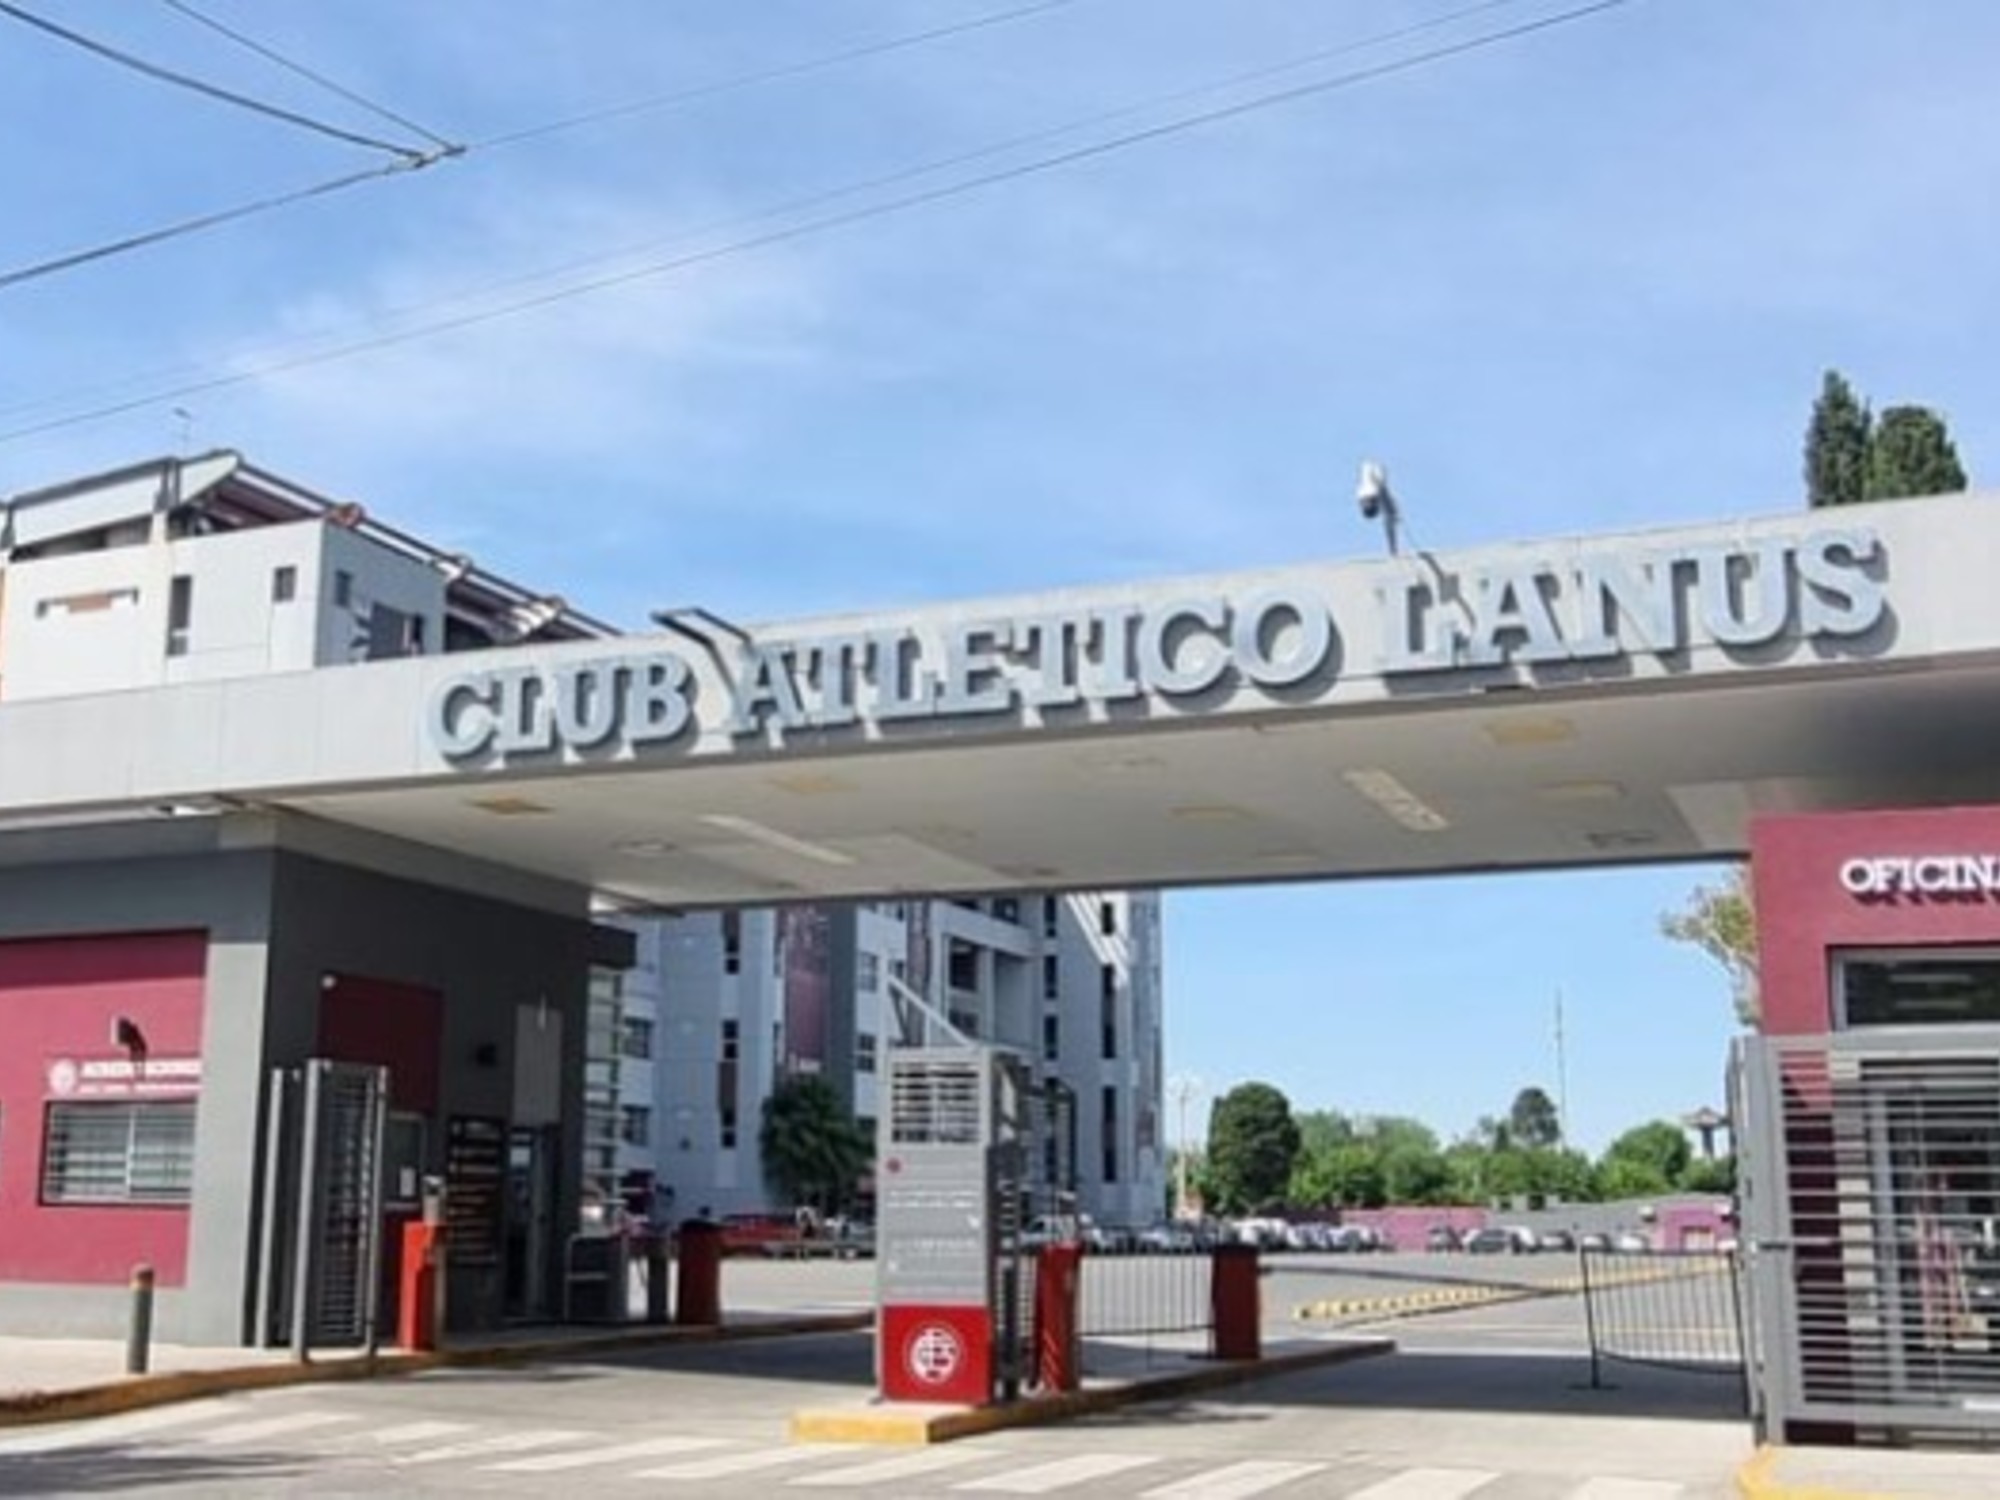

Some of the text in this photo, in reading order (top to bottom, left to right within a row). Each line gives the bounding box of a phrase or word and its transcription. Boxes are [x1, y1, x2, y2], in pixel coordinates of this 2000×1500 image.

[427, 528, 1884, 757] CLUB ATLETICO LANUS
[1840, 856, 2000, 892] OFICIN
